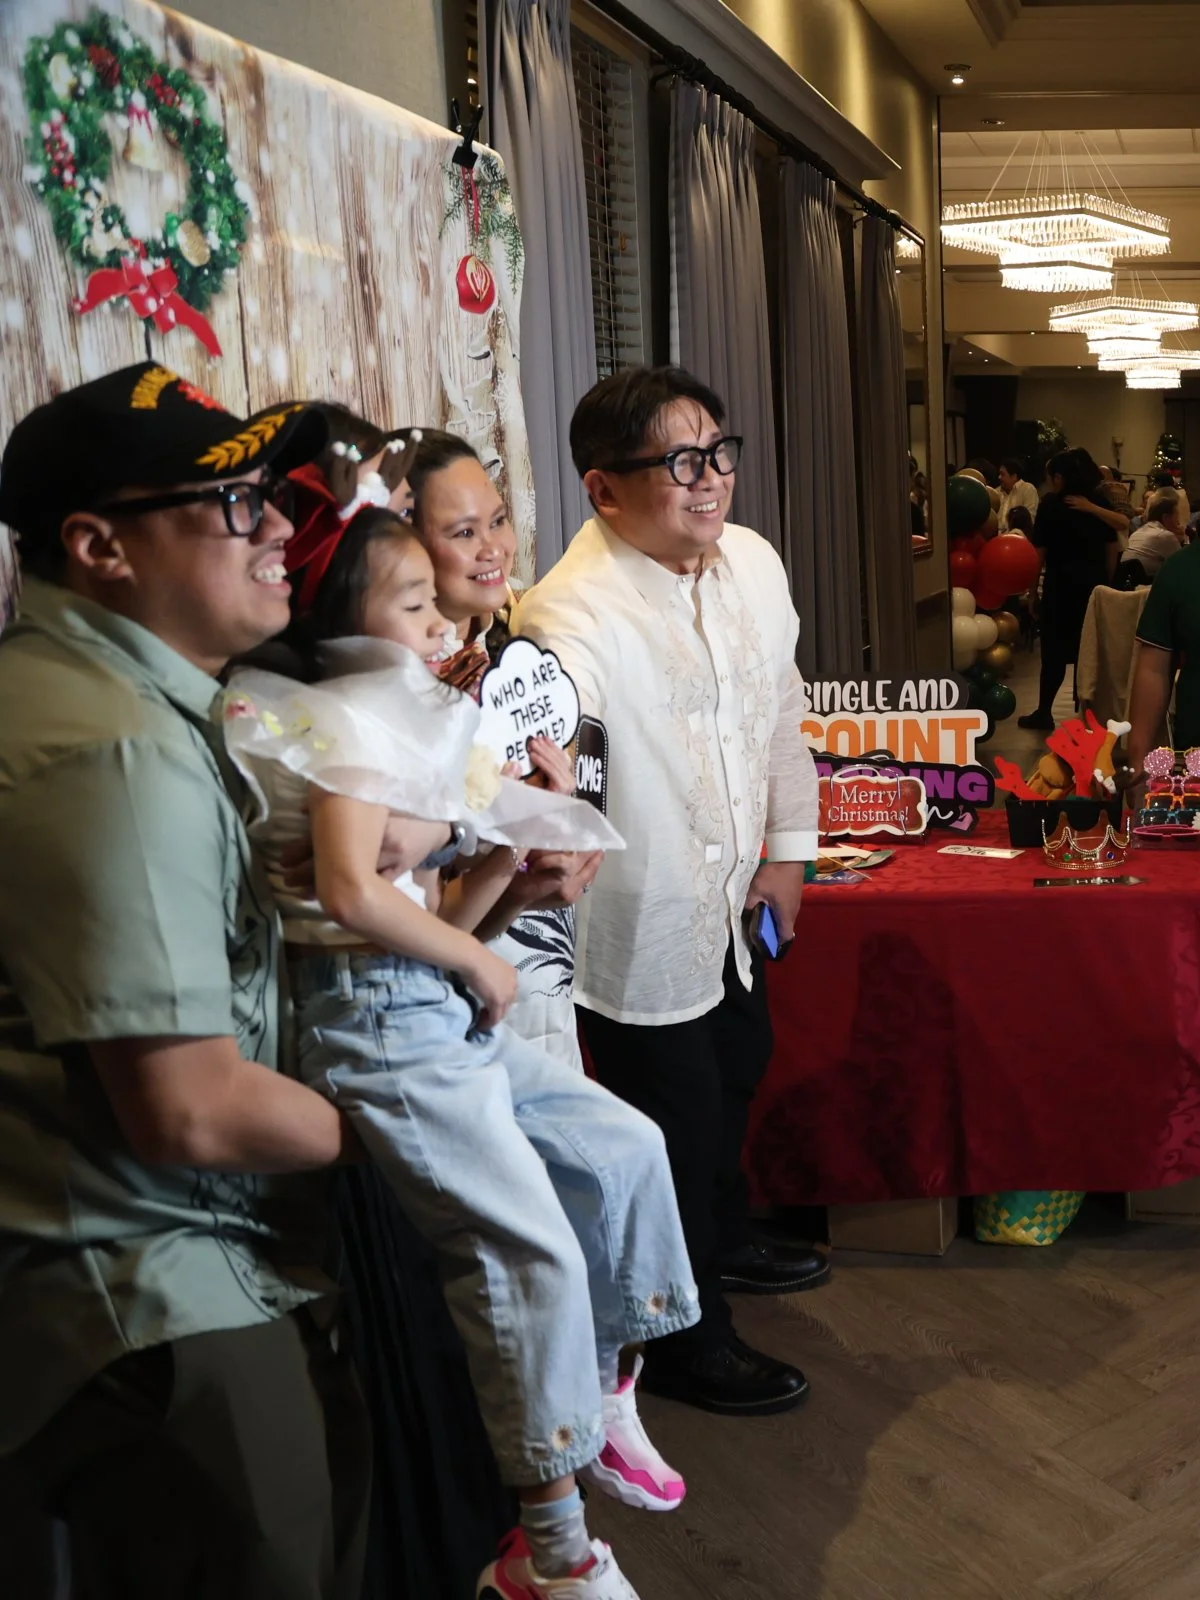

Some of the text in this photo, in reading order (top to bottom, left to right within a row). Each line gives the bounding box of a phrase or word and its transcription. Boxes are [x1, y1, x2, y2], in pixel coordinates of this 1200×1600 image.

[489, 661, 557, 711] WHO ARE
[802, 678, 959, 712] SINGLE AND
[510, 694, 554, 732] THESE
[576, 754, 602, 794] OMG
[828, 805, 909, 822] Christmas!
[839, 785, 897, 807] Merry
